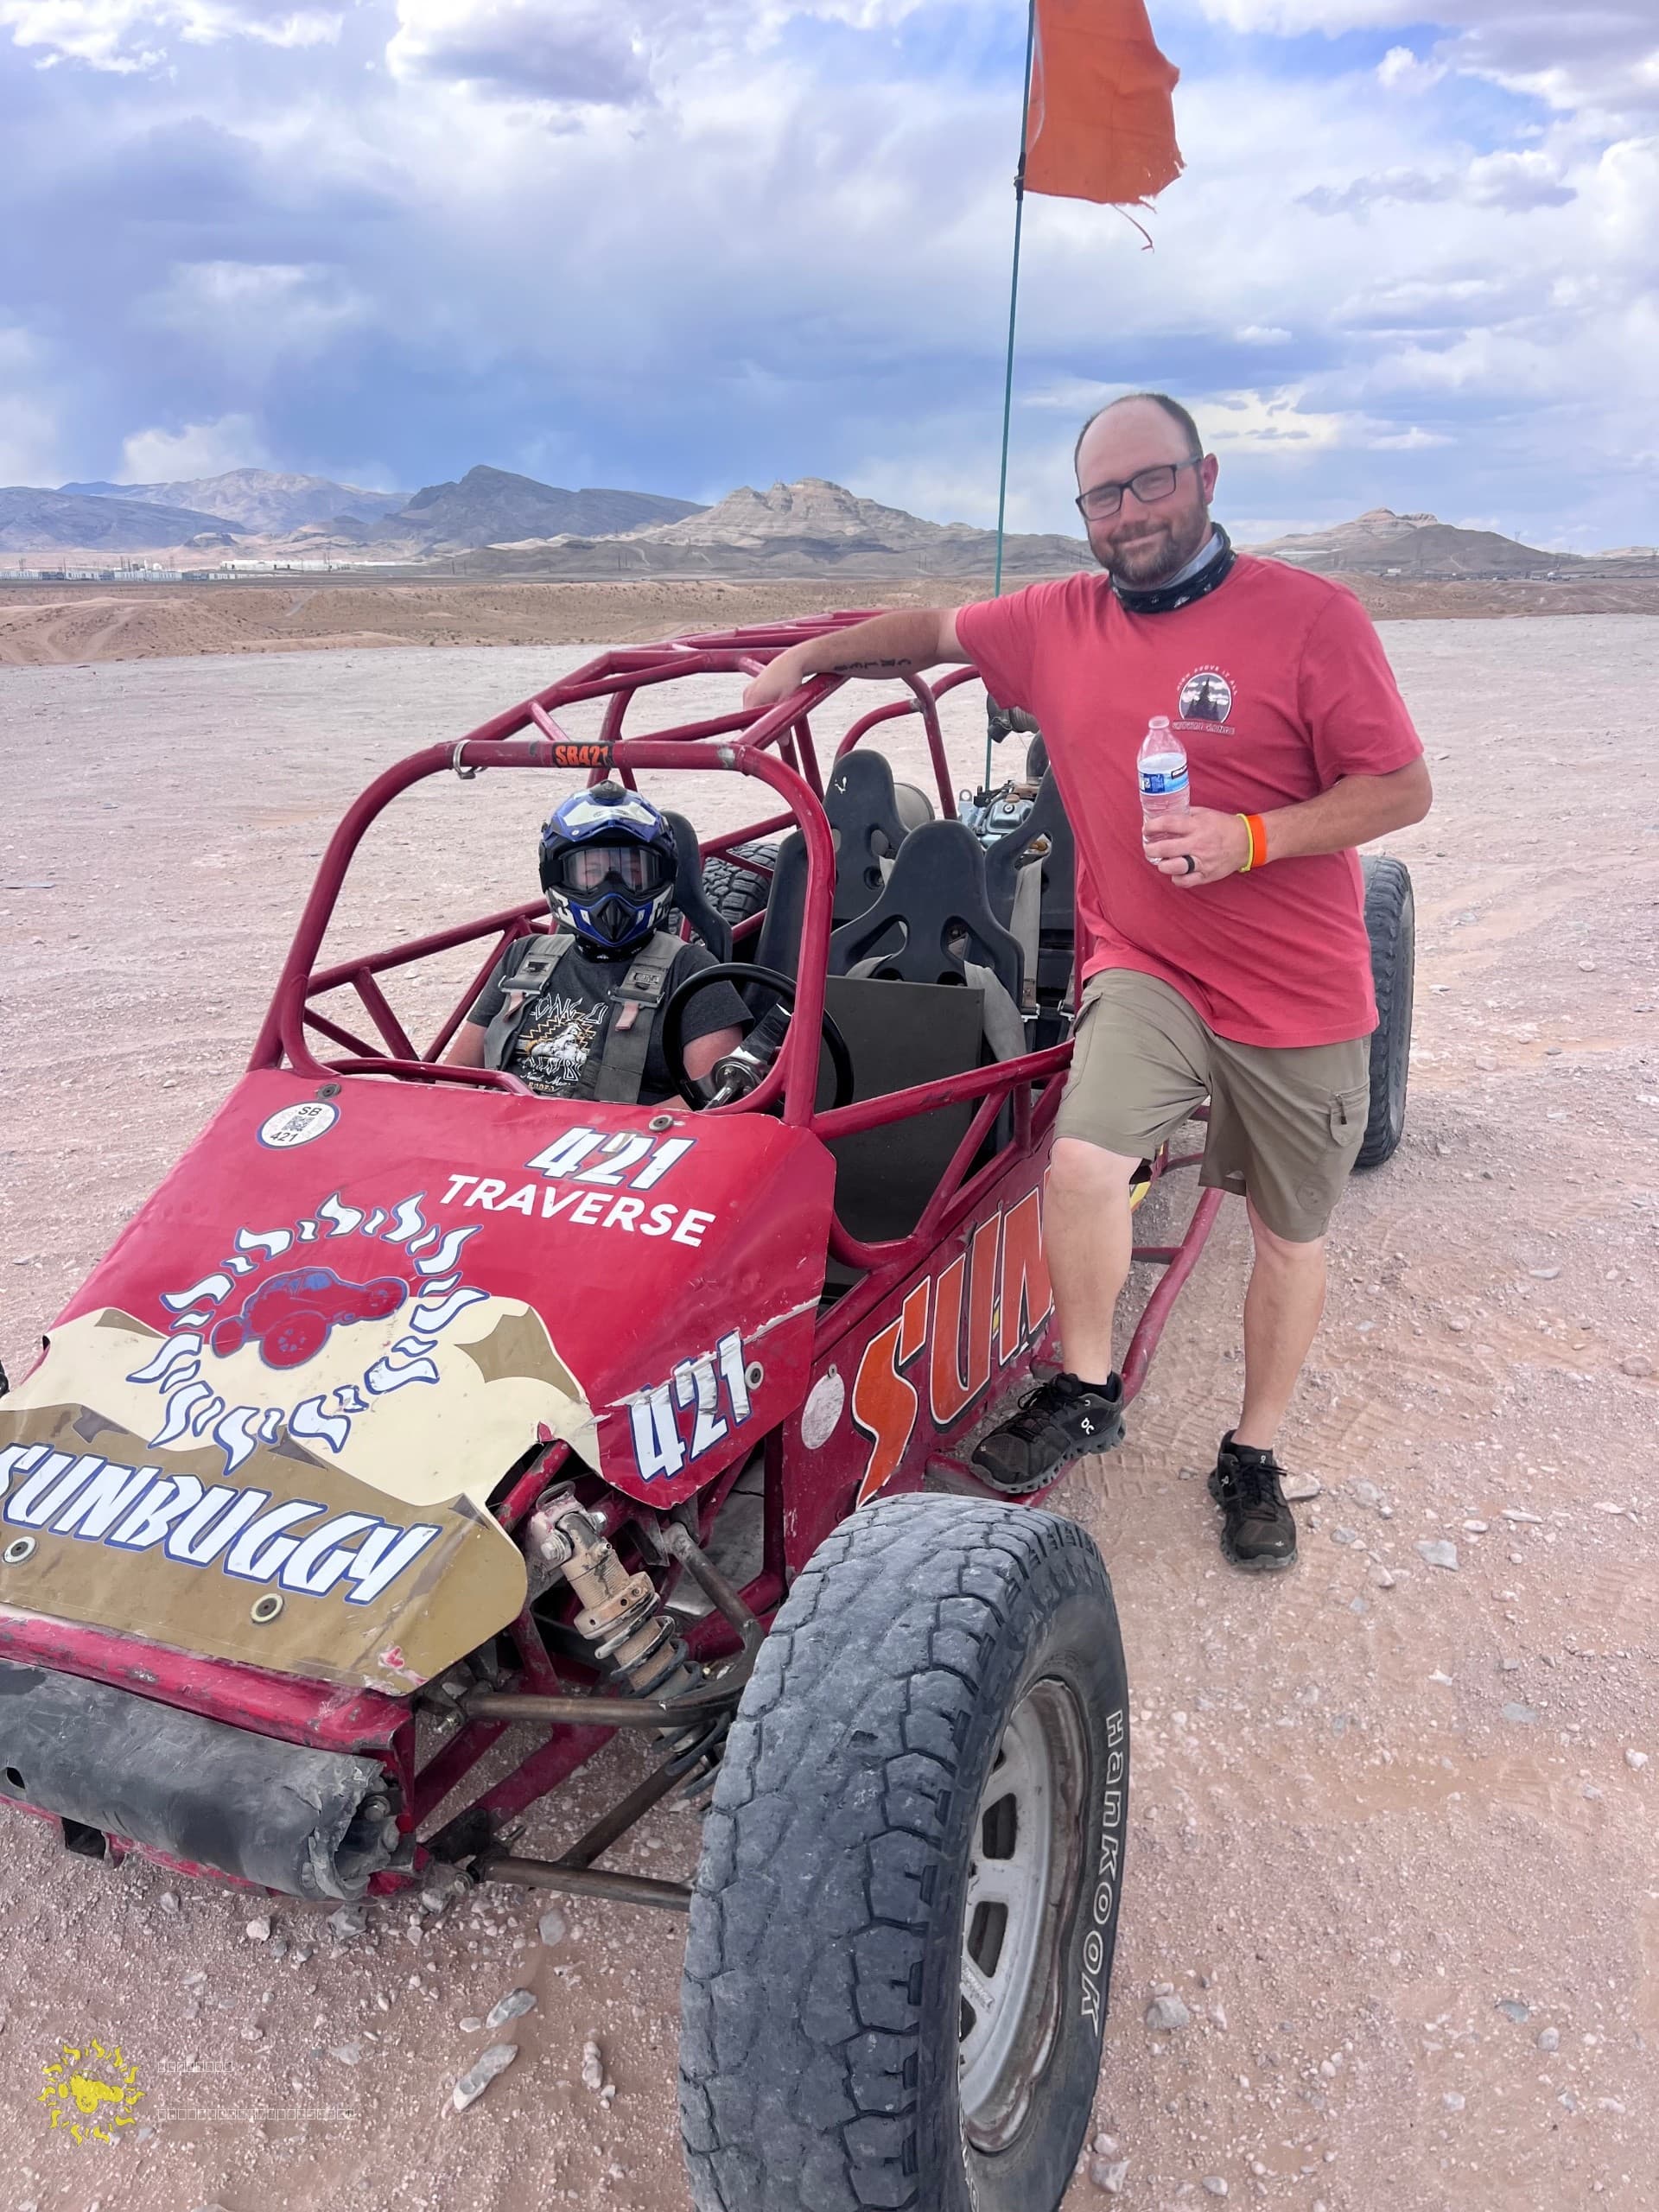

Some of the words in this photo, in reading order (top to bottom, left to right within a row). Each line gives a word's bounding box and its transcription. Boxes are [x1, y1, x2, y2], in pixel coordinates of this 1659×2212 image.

[555, 744, 608, 767] SB421
[298, 1106, 323, 1116] SB
[270, 1131, 298, 1142] 421
[525, 1126, 696, 1191] 421
[439, 1173, 716, 1248] TRAVERSE
[629, 1331, 754, 1484] 421
